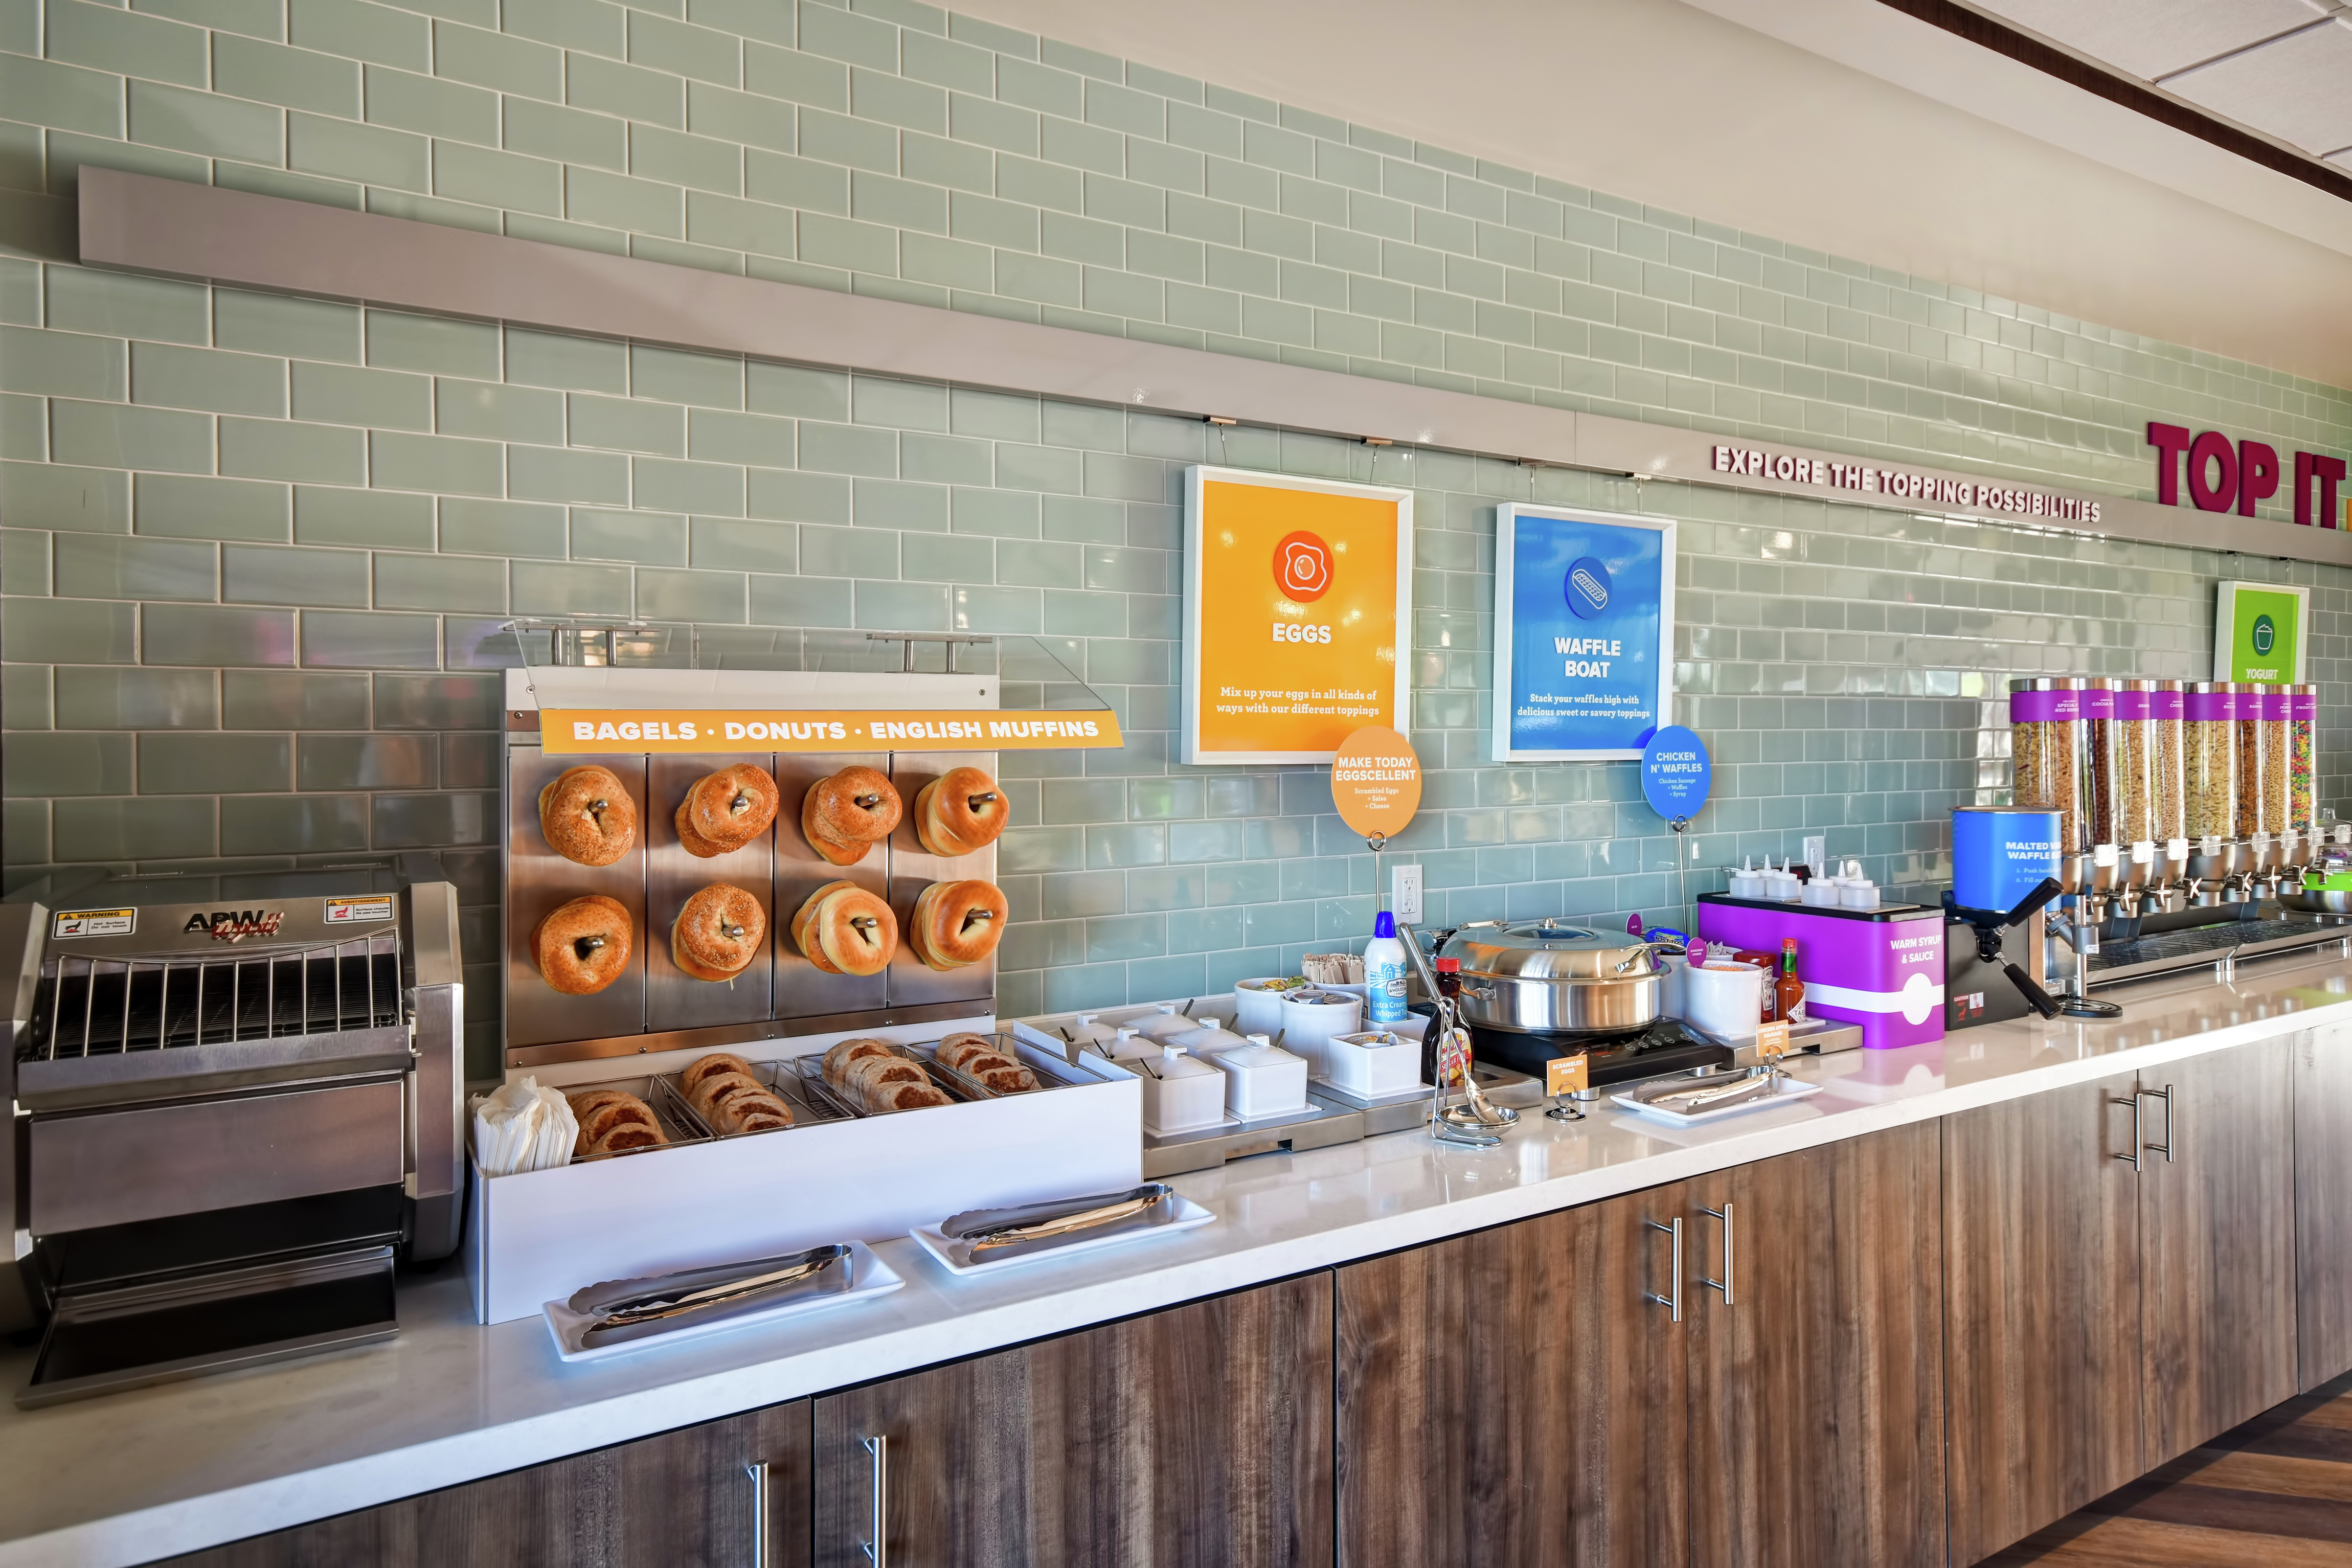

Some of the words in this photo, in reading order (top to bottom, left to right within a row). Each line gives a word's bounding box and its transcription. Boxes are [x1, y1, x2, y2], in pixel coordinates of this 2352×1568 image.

[2147, 422, 2279, 517] TOP
[2295, 451, 2346, 530] IT
[1712, 445, 1824, 485] EXPLORE
[1830, 463, 1873, 491] THE
[1879, 470, 1971, 505] TOPPING
[1974, 485, 2100, 522] POSSIBILITIES
[1272, 623, 1331, 644] EGGS
[1554, 638, 1621, 656] WAFFLE
[1565, 661, 1610, 677] BOAT
[2246, 668, 2278, 680] YOGURT
[1220, 687, 1241, 696] Mix
[1244, 690, 1257, 699] up
[1259, 690, 1283, 699] your
[1285, 690, 1309, 701] eggs
[1311, 689, 1321, 699] in
[1323, 689, 1336, 699] all
[1338, 689, 1365, 700] kinds
[1367, 690, 1377, 700] of
[1530, 693, 1553, 702] Stack
[1554, 696, 1573, 705] your
[1574, 694, 1603, 703] waffles
[1604, 694, 1621, 706] high
[1622, 695, 1639, 704] with
[1216, 705, 1243, 715] ways
[1246, 702, 1269, 713] with
[1271, 705, 1289, 713] our
[1291, 703, 1335, 714] different
[1337, 705, 1379, 717] toppings
[1518, 707, 1554, 716] delicious
[1590, 710, 1616, 718] savory
[1617, 709, 1650, 719] toppings
[573, 722, 697, 740] BAGELS
[725, 722, 846, 739] DONUTS
[870, 721, 982, 739] ENGLISH
[989, 721, 1098, 738] MUFFINS
[1339, 757, 1371, 768] MAKE
[1375, 757, 1413, 767] TODAY
[1657, 752, 1696, 761] CHICKEN
[1662, 763, 1702, 772] WAFFLES
[1336, 770, 1416, 781] EGGSCELLENT
[2007, 851, 2050, 859] WAFFLE
[184, 910, 264, 933] APW
[1890, 938, 1917, 949] WARM
[1918, 935, 1941, 946] SYRUP
[1902, 955, 1907, 964] &
[1909, 951, 1934, 963] SAUCE
[1375, 1009, 1400, 1018] Whipped
[1552, 1060, 1583, 1070] SCRAMBLED
